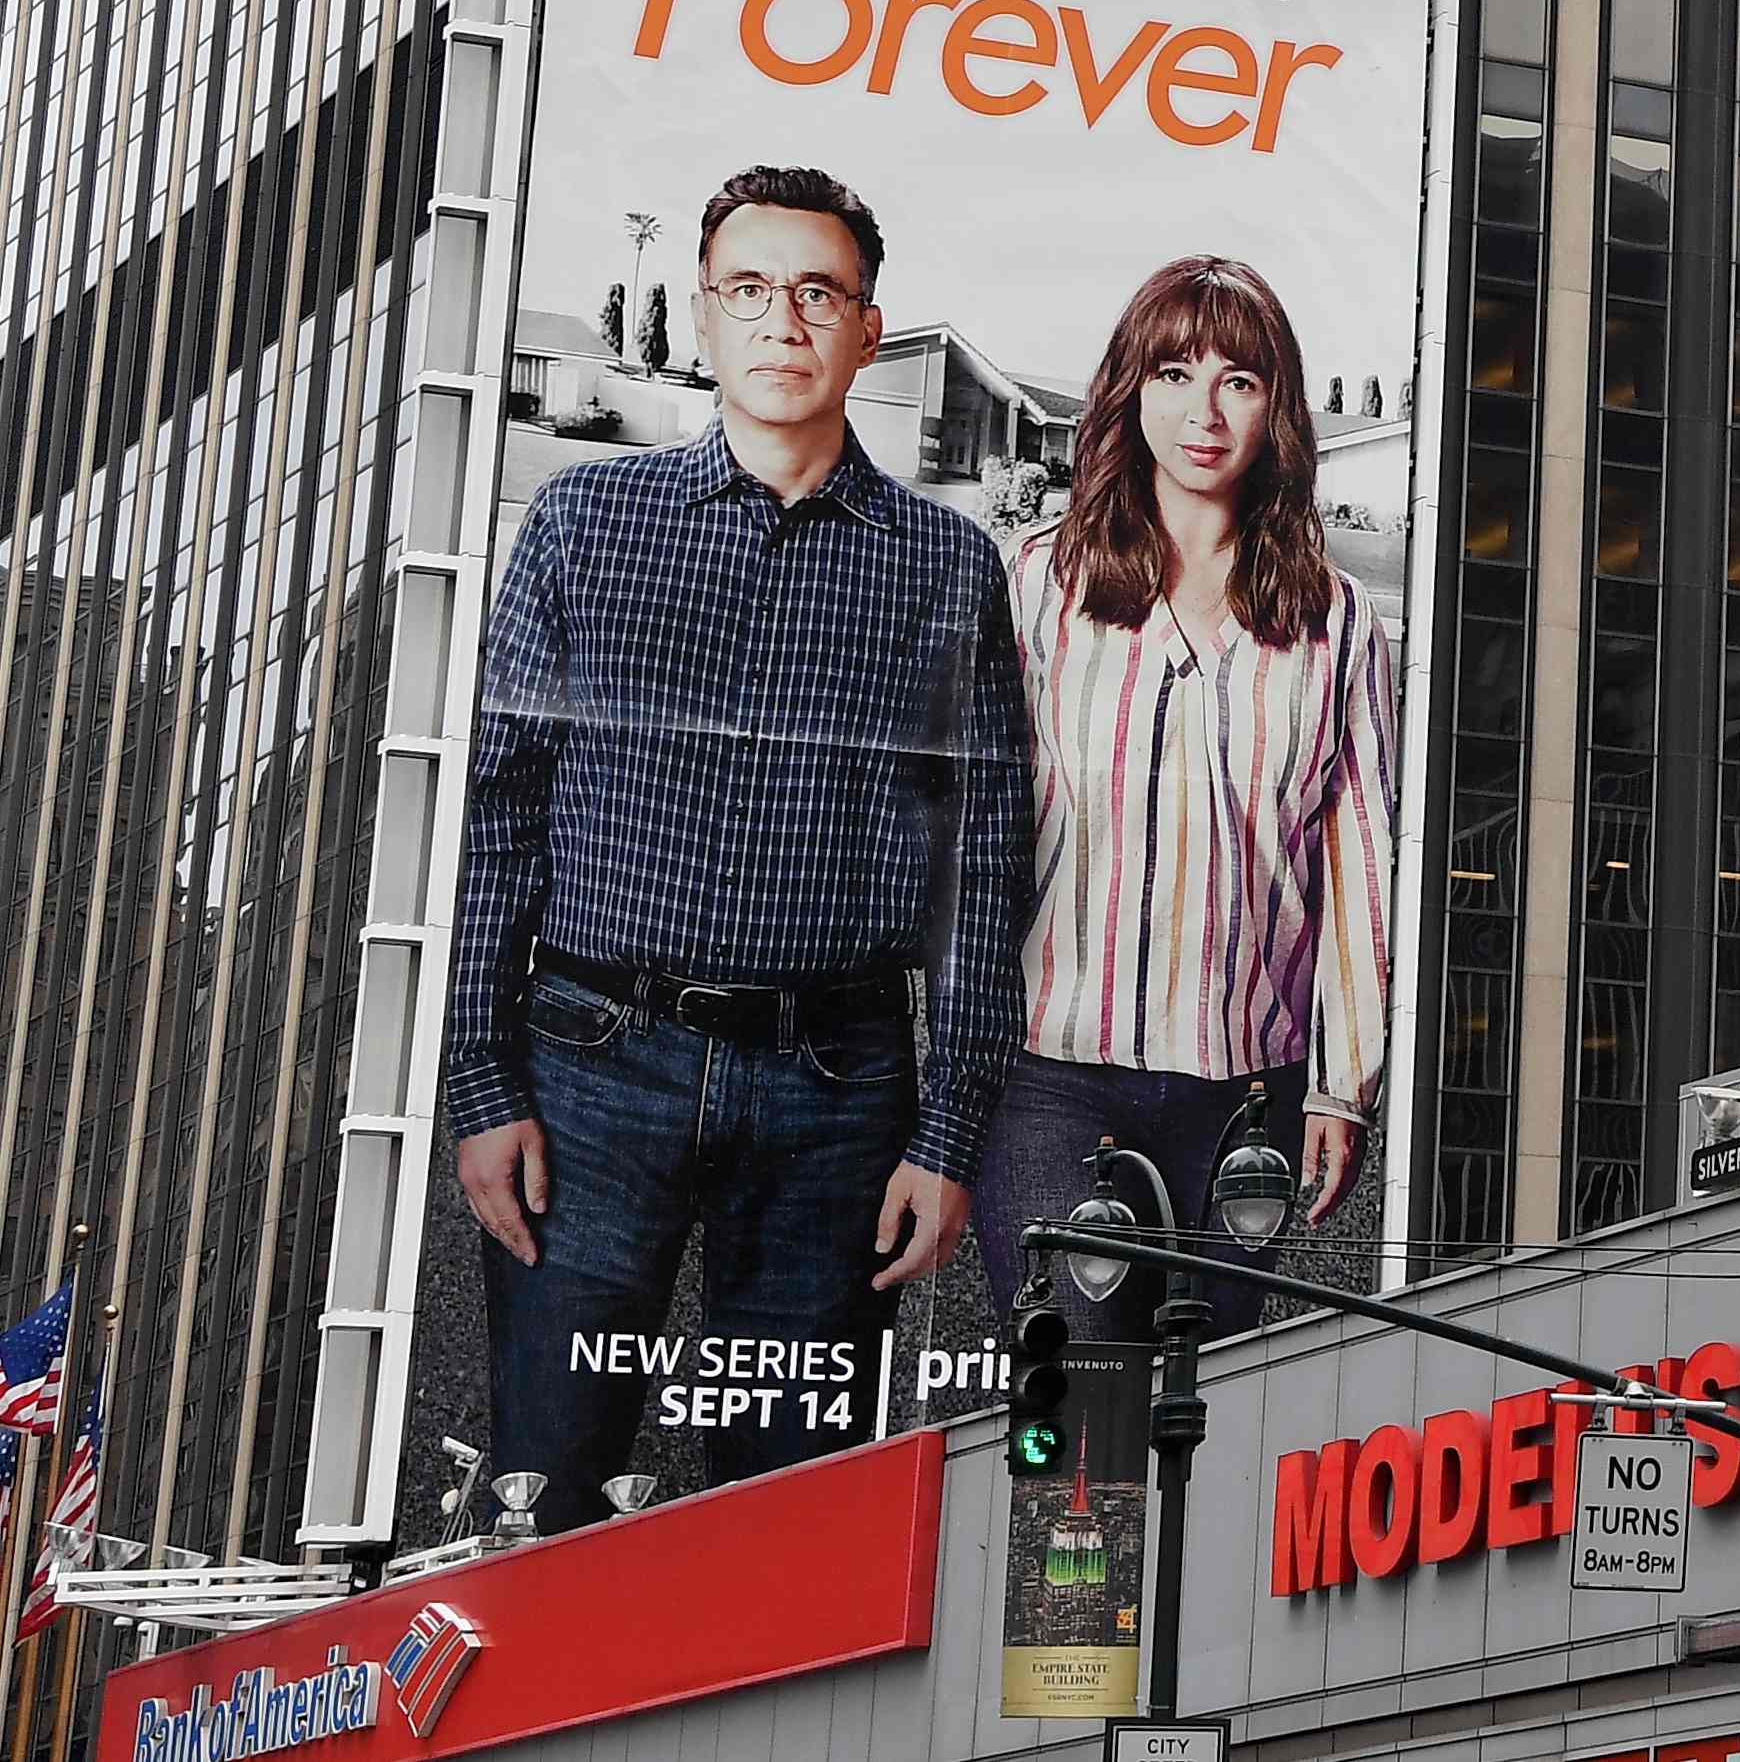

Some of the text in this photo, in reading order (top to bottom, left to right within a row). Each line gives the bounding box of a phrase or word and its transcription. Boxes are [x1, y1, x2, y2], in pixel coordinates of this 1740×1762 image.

[570, 1332, 855, 1382] NEW SERIES
[659, 1385, 853, 1431] SEPT 14
[1607, 1455, 1662, 1491] NO
[1584, 1505, 1680, 1537] TURNS
[1583, 1548, 1676, 1575] 8AM-8PM
[1043, 1675, 1100, 1686] BUILDING
[131, 1644, 381, 1762] Bank of America
[1147, 1738, 1190, 1755] CITY
